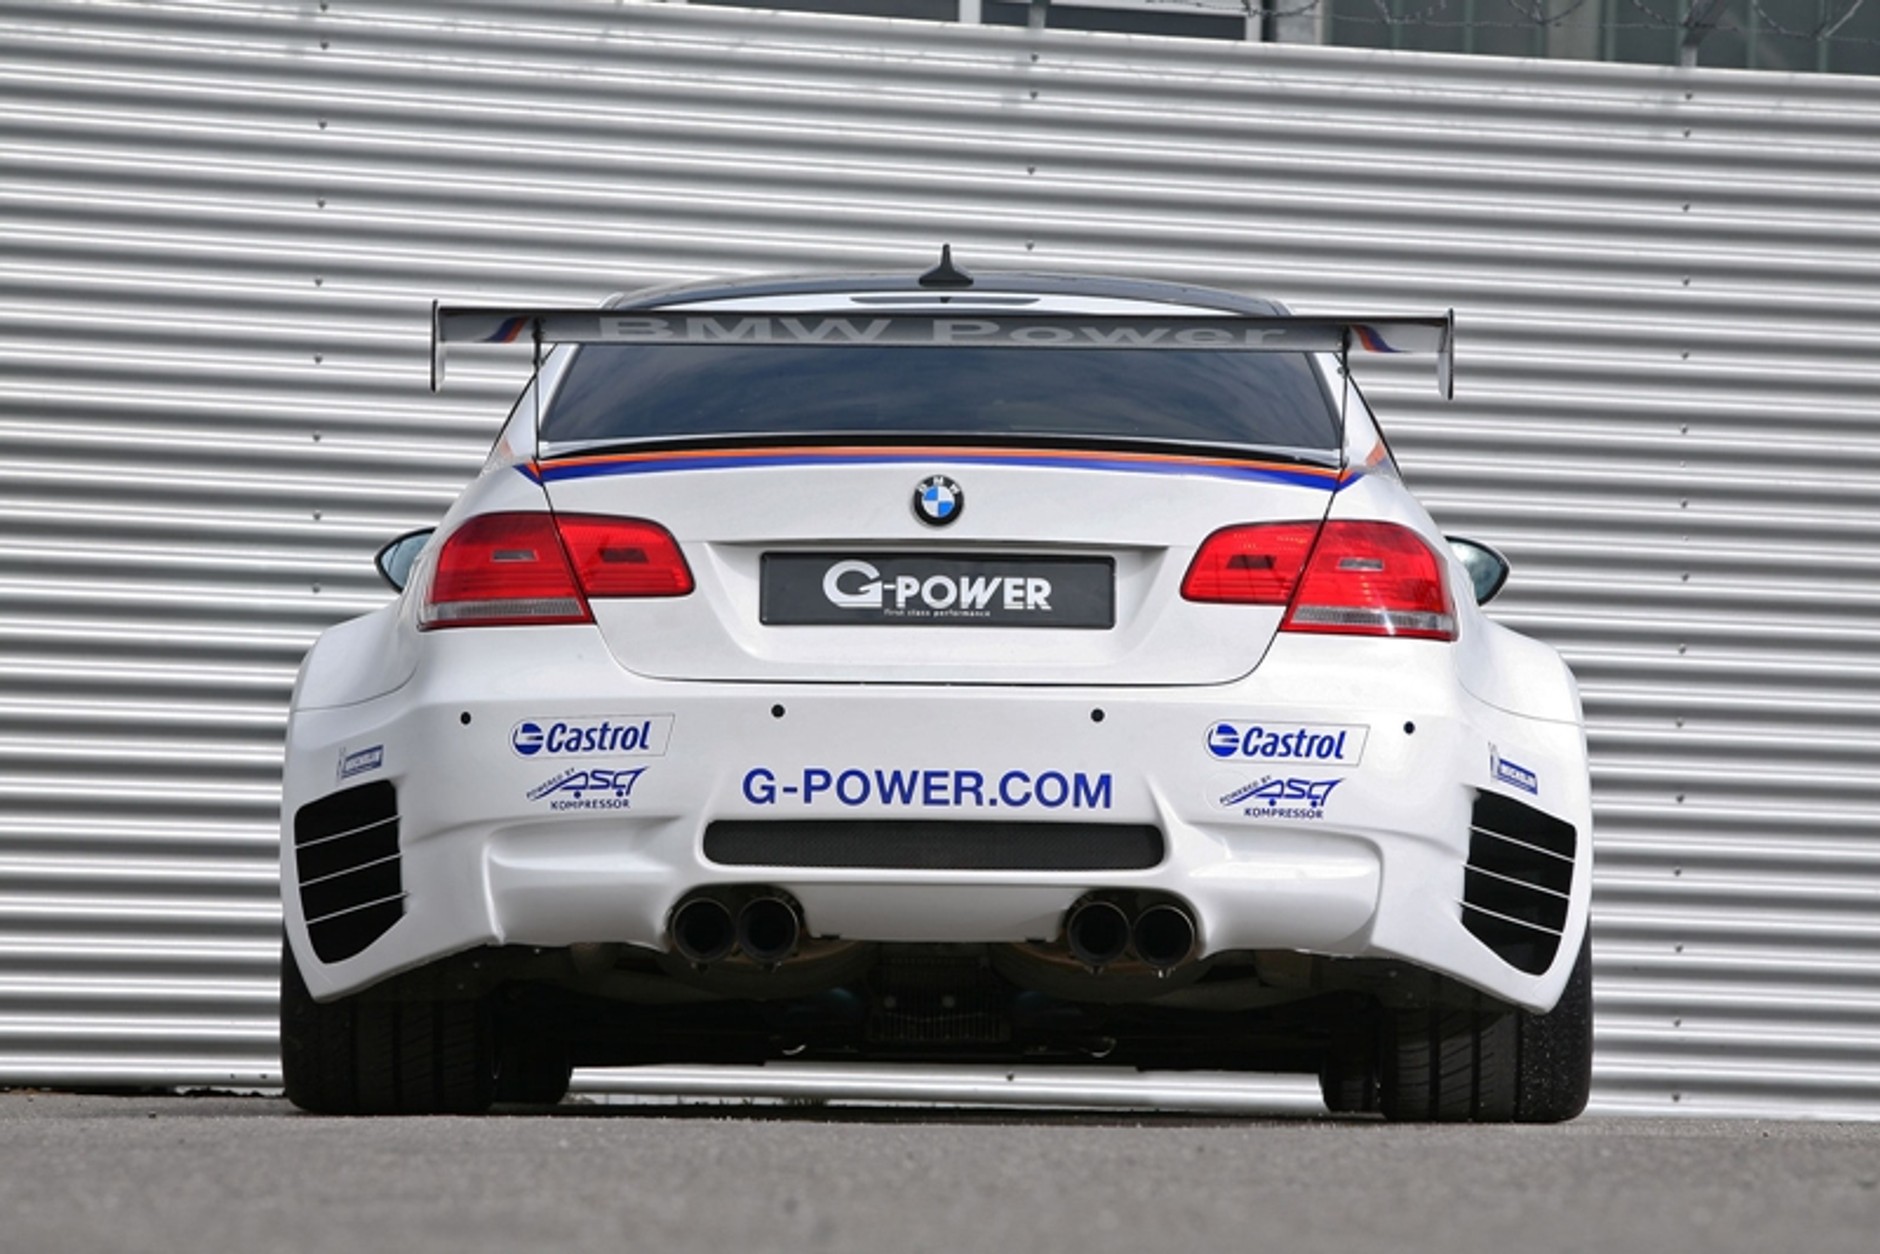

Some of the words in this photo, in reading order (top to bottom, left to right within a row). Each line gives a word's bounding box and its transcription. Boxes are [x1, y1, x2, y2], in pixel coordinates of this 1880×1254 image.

[600, 316, 893, 342] BMW
[932, 319, 1288, 346] Power
[822, 559, 1052, 610] G-POWER
[546, 720, 651, 753] Castrol
[1242, 726, 1346, 760] Castrol
[742, 767, 1113, 809] G-POWER.COM
[550, 799, 631, 811] KOMPRESSOR
[1243, 807, 1324, 819] KOMPRESSOR
